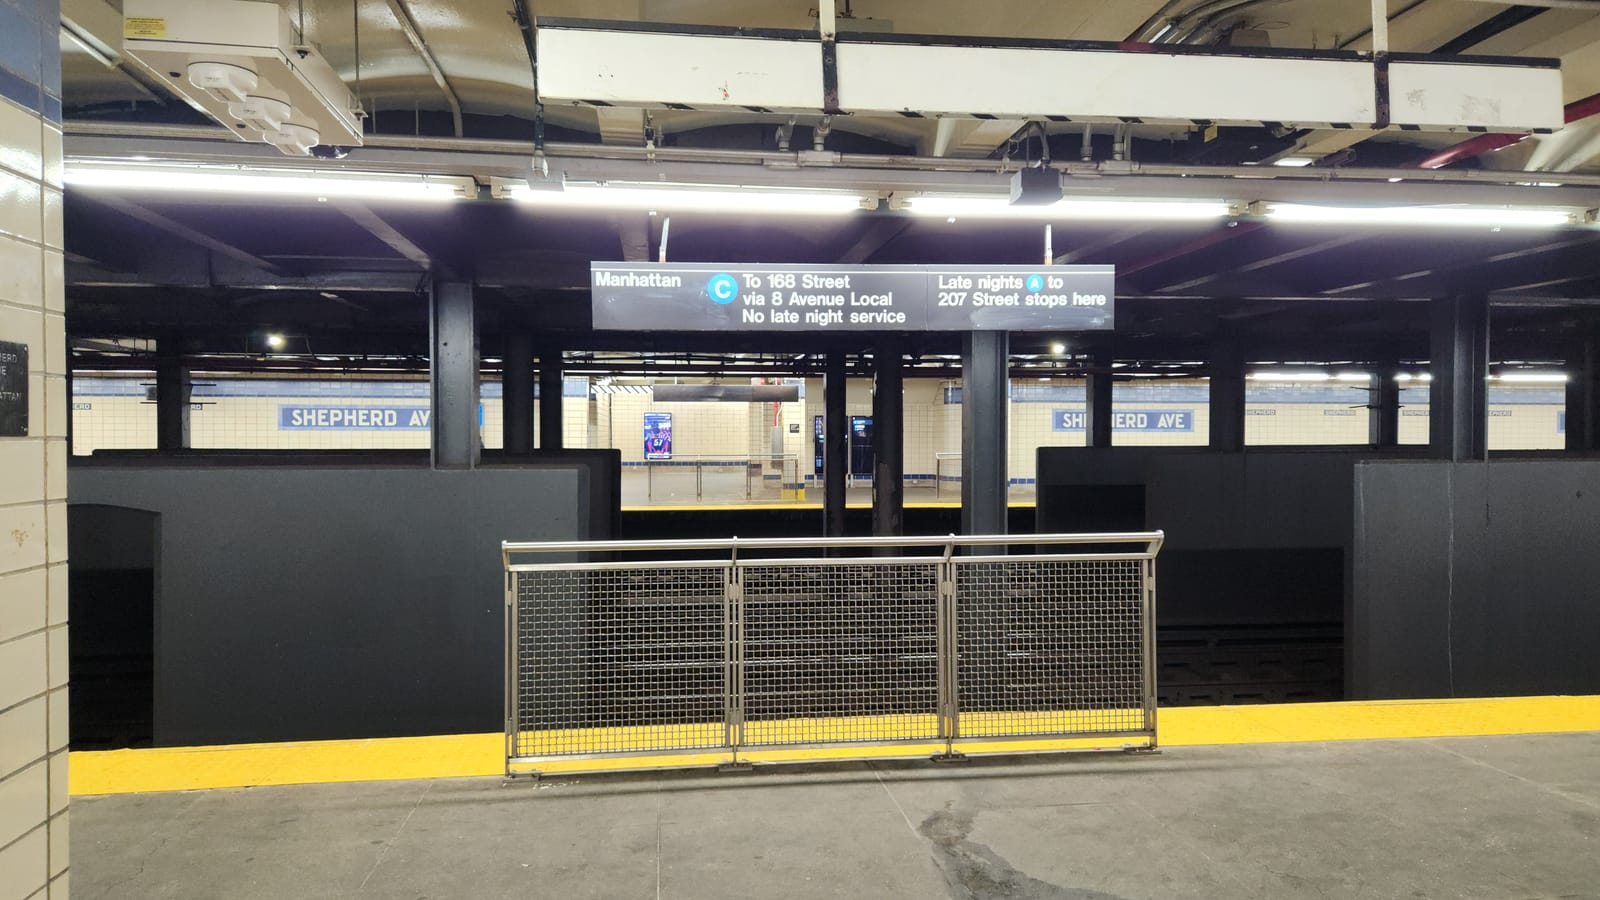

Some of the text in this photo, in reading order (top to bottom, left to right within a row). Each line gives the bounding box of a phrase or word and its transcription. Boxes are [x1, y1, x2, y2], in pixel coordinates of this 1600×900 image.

[595, 272, 681, 287] Manhattan
[742, 274, 850, 288] To 168 Street
[938, 275, 972, 289] Late
[978, 275, 1024, 292] nights
[1048, 276, 1064, 289] to
[714, 279, 731, 299] C
[742, 291, 892, 306] via 8 Avenue Local
[938, 292, 1106, 308] 207 Street stops here
[742, 309, 906, 326] No late night service
[0, 353, 17, 363] ERD
[291, 409, 397, 426] SHEPHERD
[1063, 413, 1185, 428] SHERD AVE
